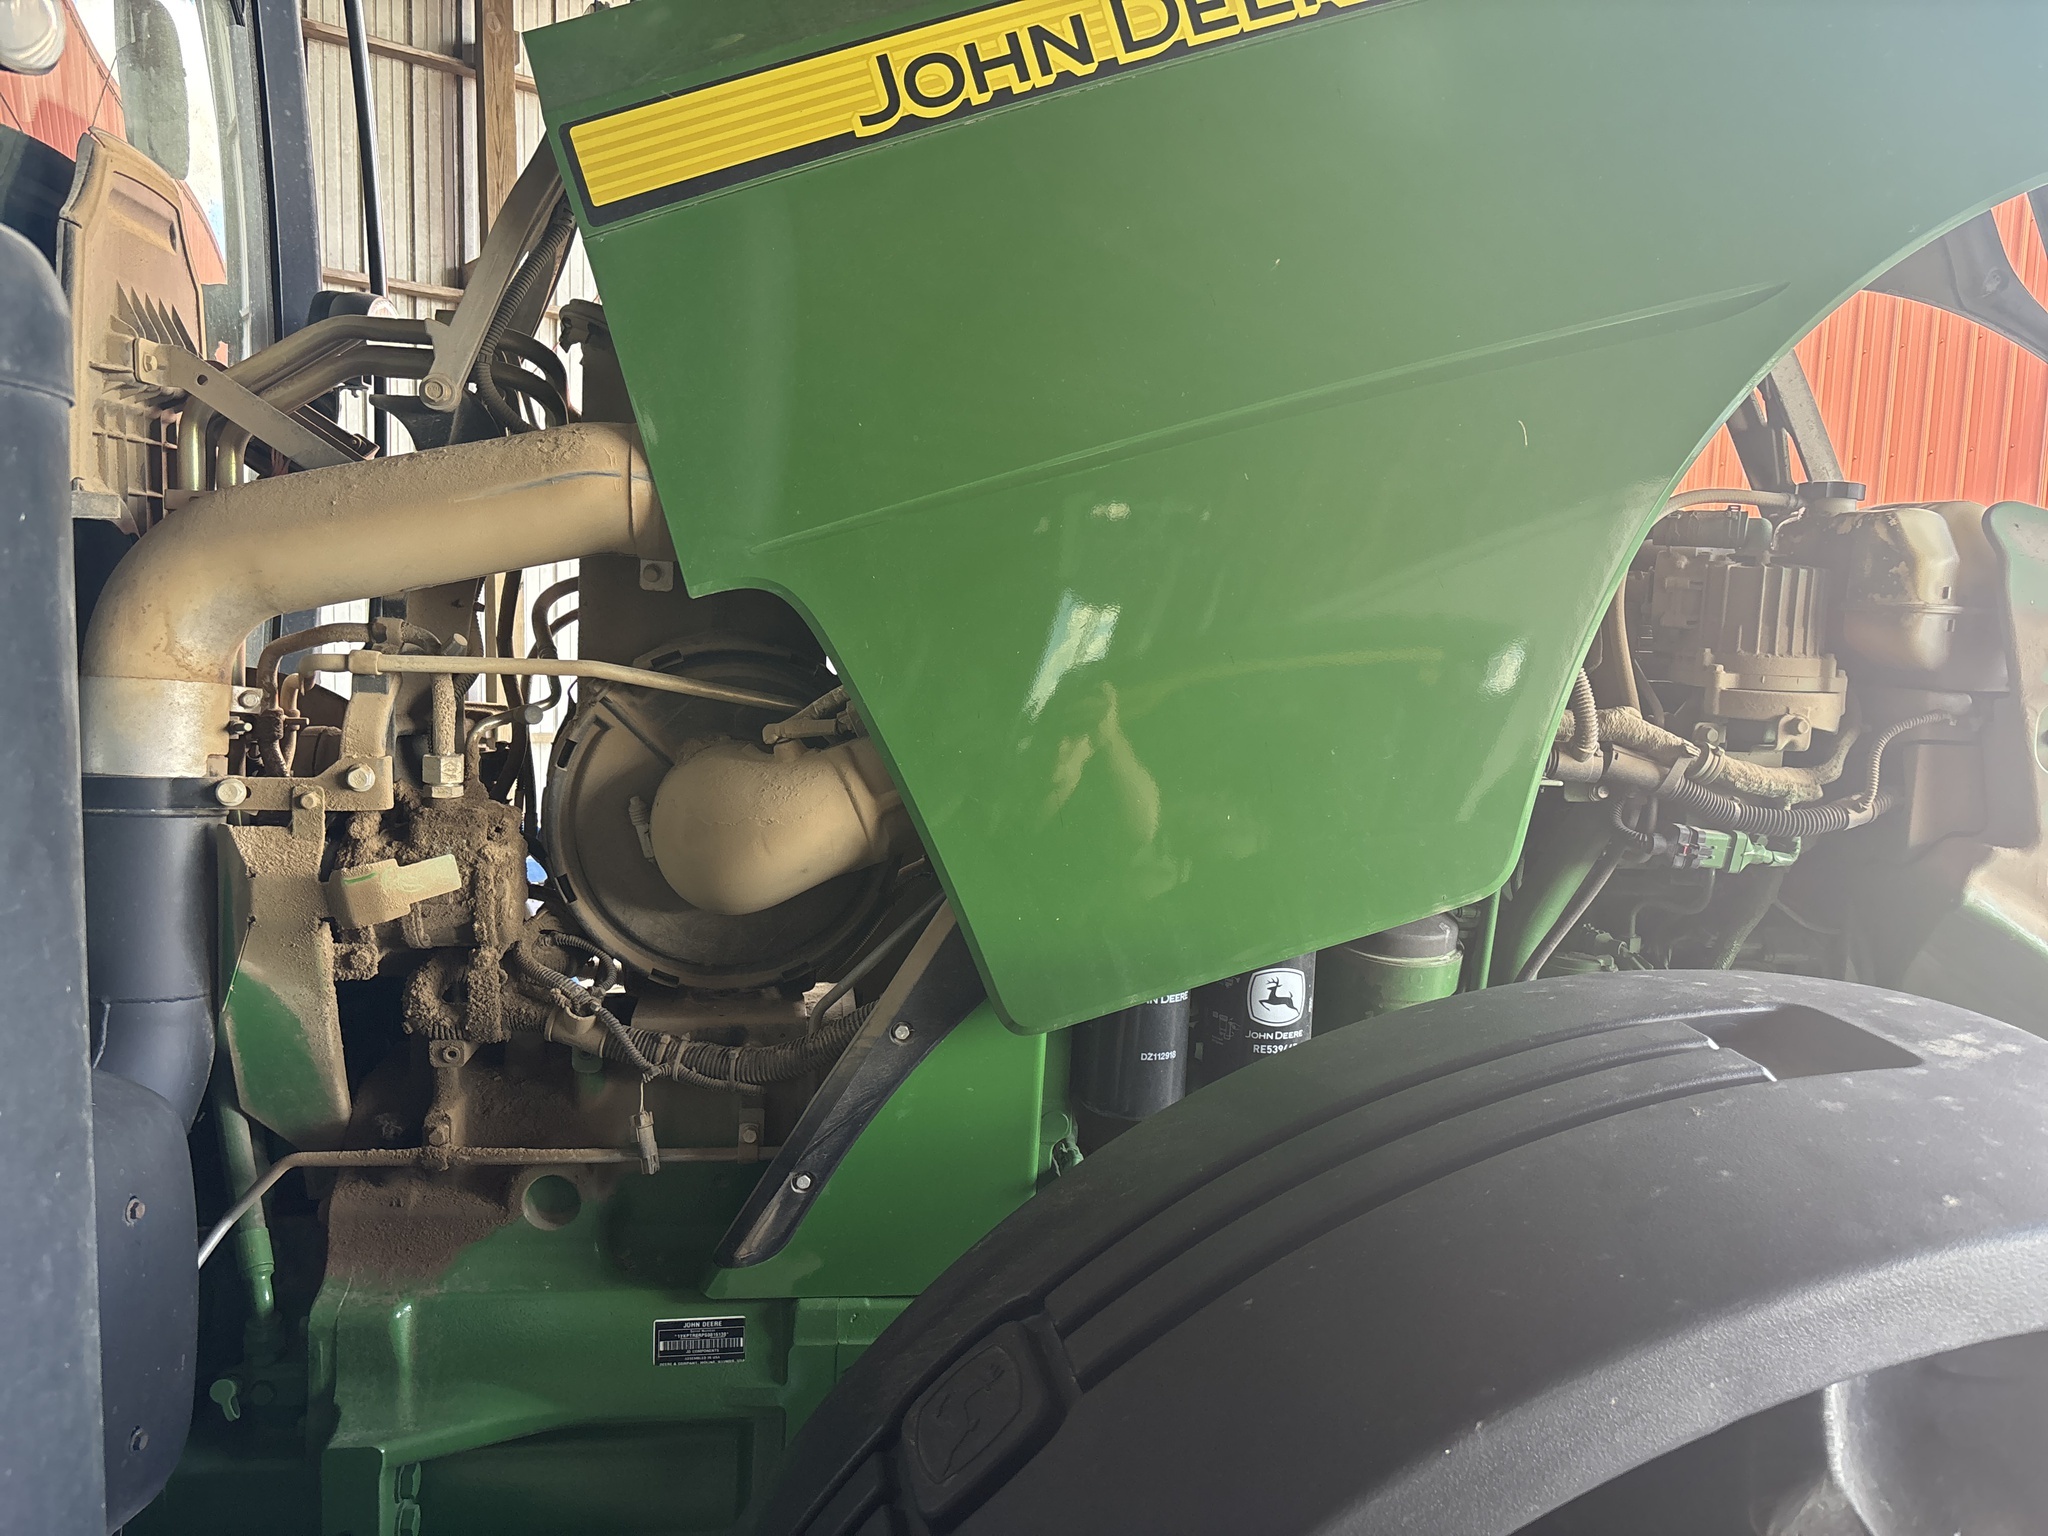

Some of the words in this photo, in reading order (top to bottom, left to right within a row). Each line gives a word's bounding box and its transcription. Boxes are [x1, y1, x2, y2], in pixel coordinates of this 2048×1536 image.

[857, 13, 1097, 130] JOHN
[1161, 991, 1189, 1004] DEERE
[1245, 1030, 1274, 1040] JOHN
[1275, 1030, 1304, 1040] DEERE
